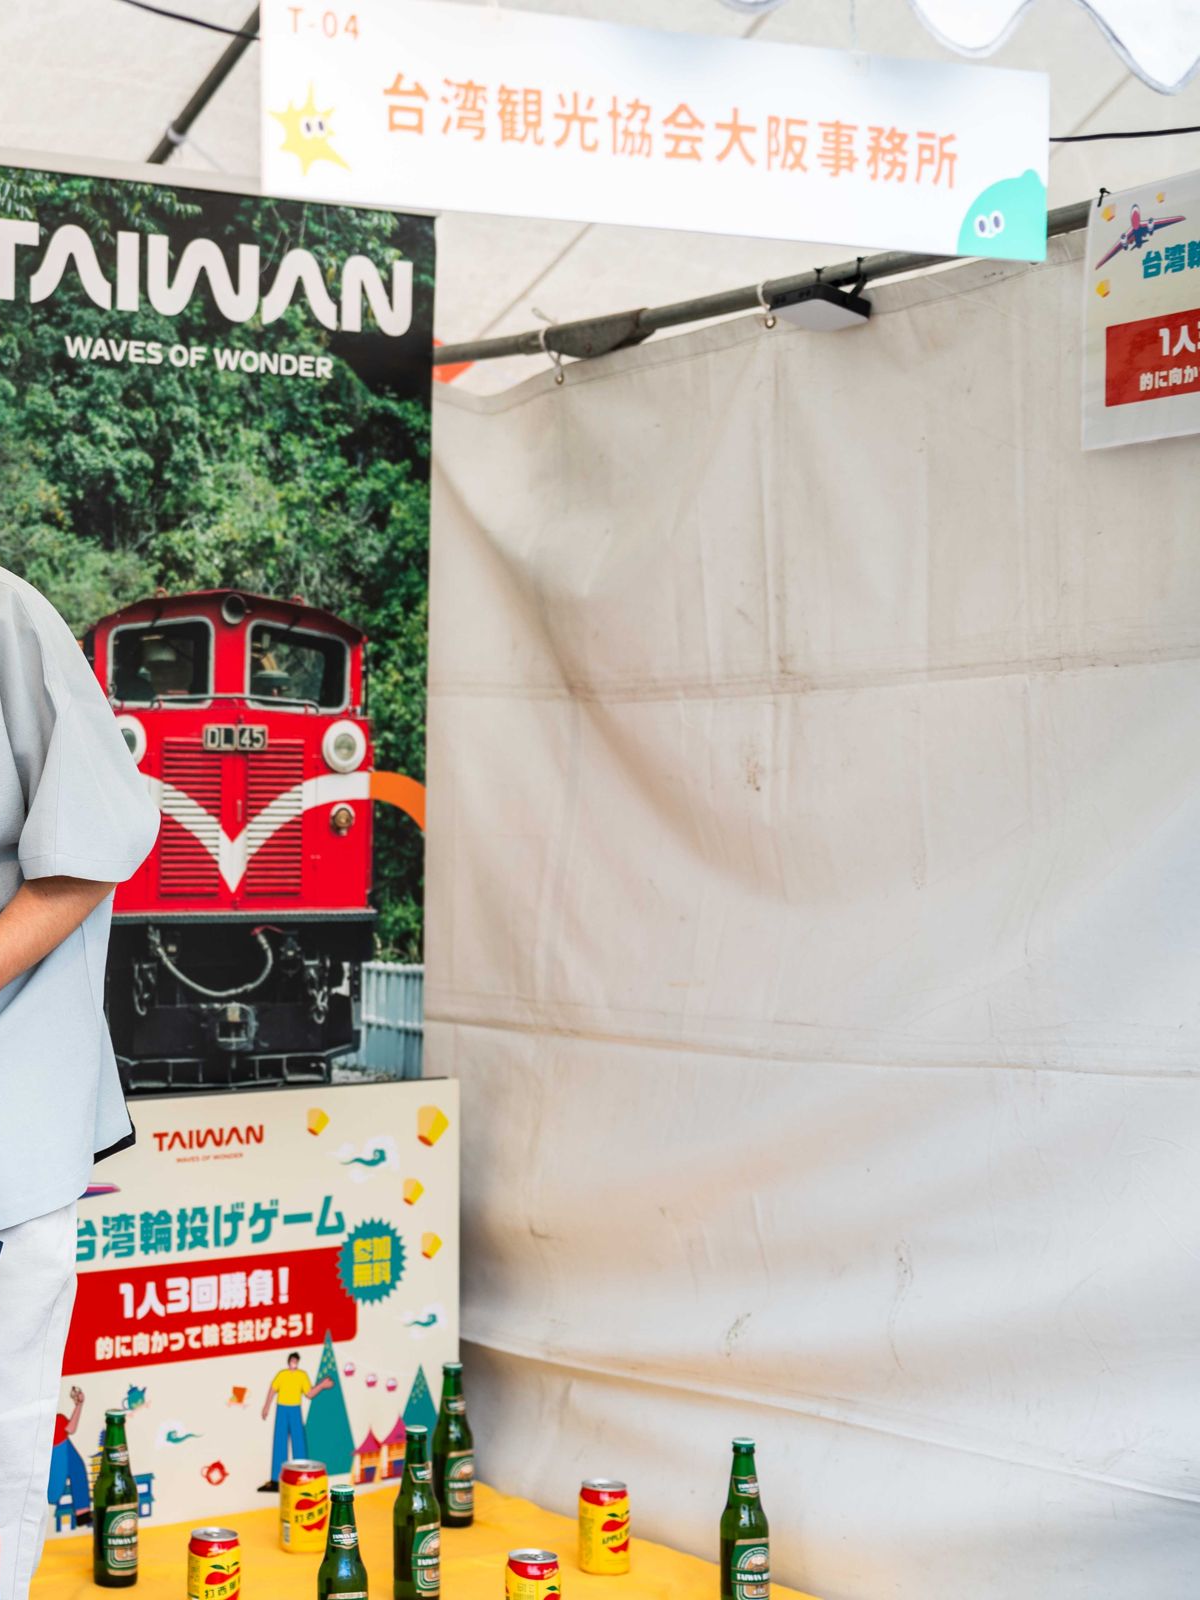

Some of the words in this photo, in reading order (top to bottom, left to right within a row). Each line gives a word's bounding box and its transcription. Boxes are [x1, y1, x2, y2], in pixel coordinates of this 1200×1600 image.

[288, 7, 359, 39] T-04
[382, 72, 959, 190] 台湾観光協会大阪事務所
[64, 335, 163, 367] WAVES
[170, 343, 205, 368] OF
[214, 348, 333, 379] WONDER
[1159, 321, 1200, 357] 1人
[239, 727, 266, 748] 45
[153, 1124, 264, 1152] TAIWAN
[76, 1195, 346, 1263] 台湾輪投げゲーム
